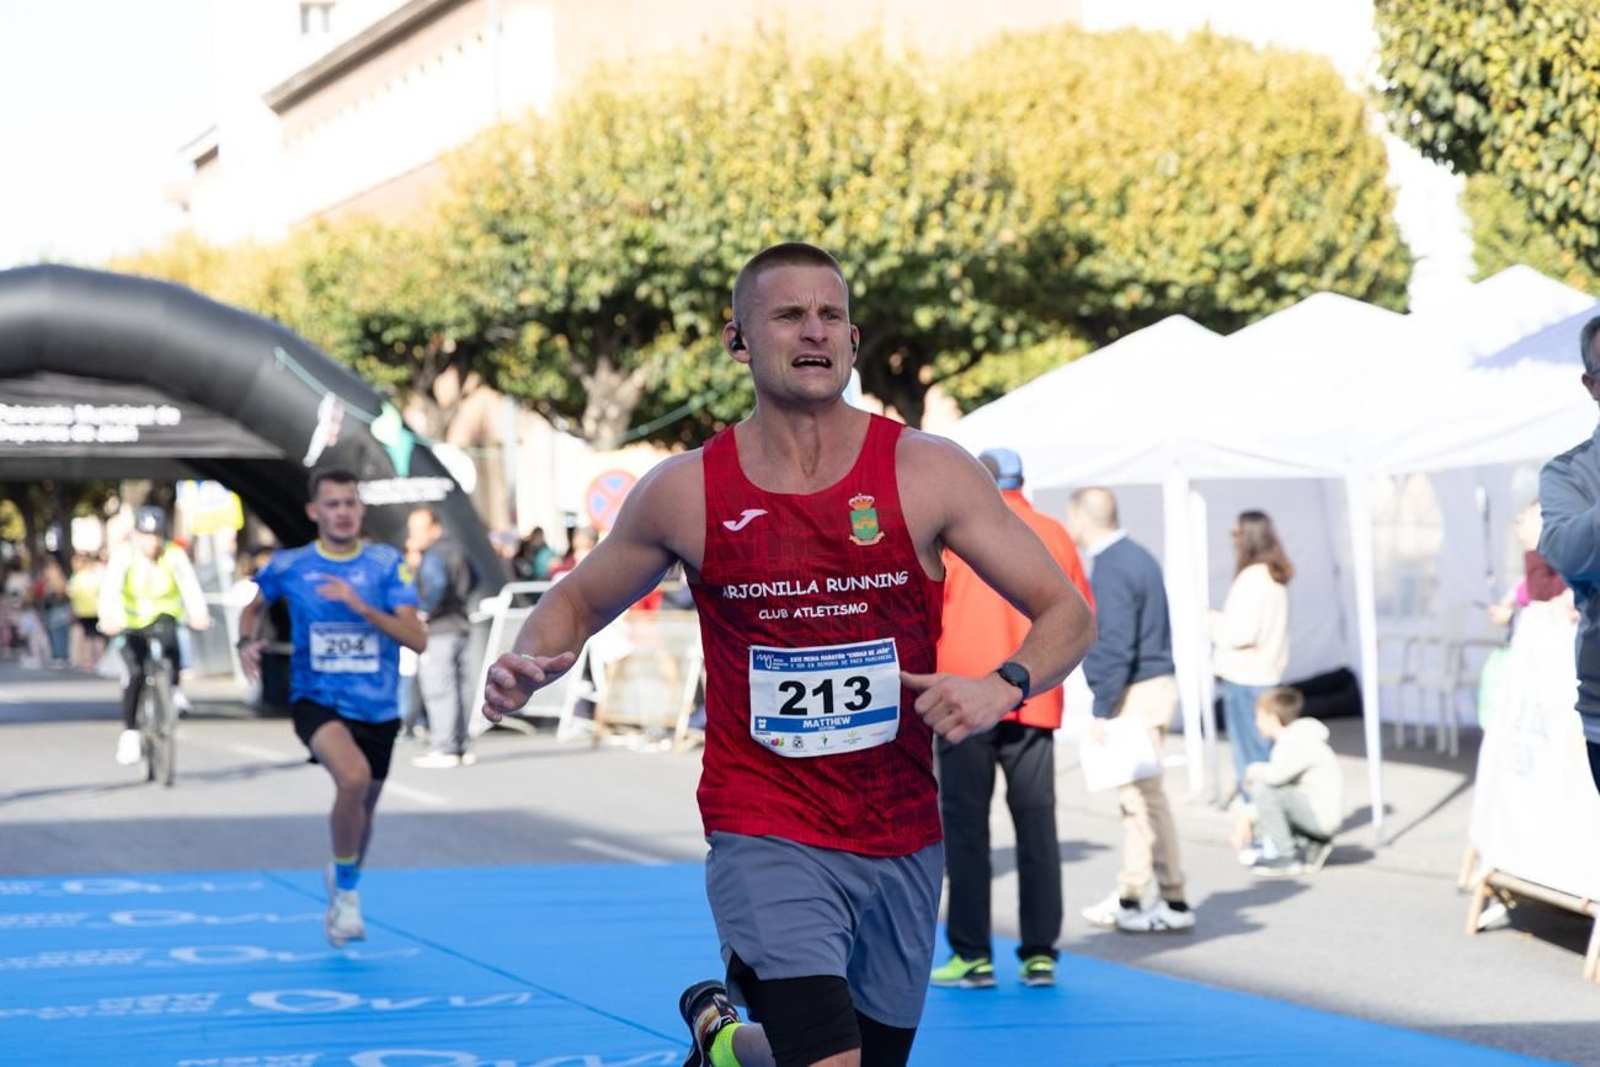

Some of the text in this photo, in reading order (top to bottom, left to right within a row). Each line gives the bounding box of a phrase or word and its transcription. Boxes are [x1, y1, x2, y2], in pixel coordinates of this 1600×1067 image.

[722, 571, 909, 599] ARJONILLA RUNNING
[758, 602, 868, 620] CLUB ATLETISMO
[325, 638, 365, 653] 204
[778, 675, 872, 716] 213
[802, 716, 851, 729] MATTHEW
